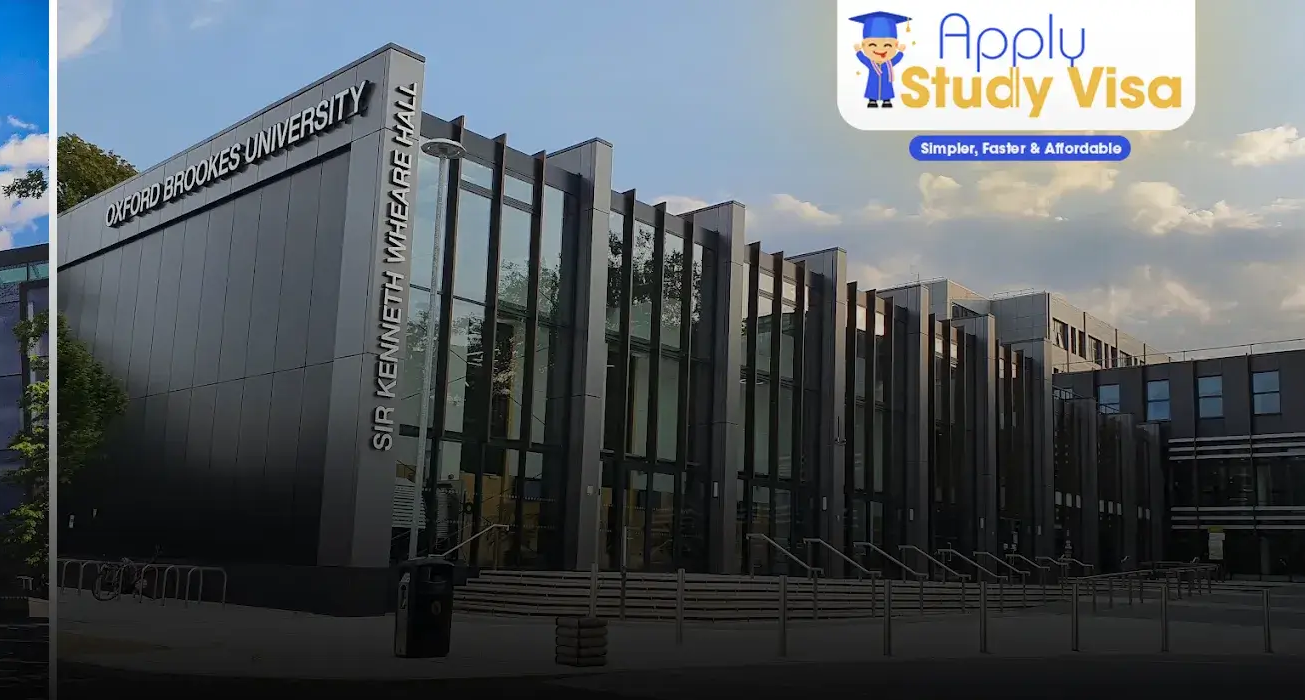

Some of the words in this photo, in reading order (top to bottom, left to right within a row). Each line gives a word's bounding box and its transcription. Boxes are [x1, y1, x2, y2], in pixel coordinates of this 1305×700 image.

[105, 183, 162, 227] OXFORD
[163, 142, 242, 201] BROOKES
[245, 80, 368, 163] UNIVERSITY
[394, 82, 418, 147] HALL
[383, 149, 413, 263] WHEARE
[376, 270, 405, 398] KENNETH
[372, 405, 395, 451] SIR
